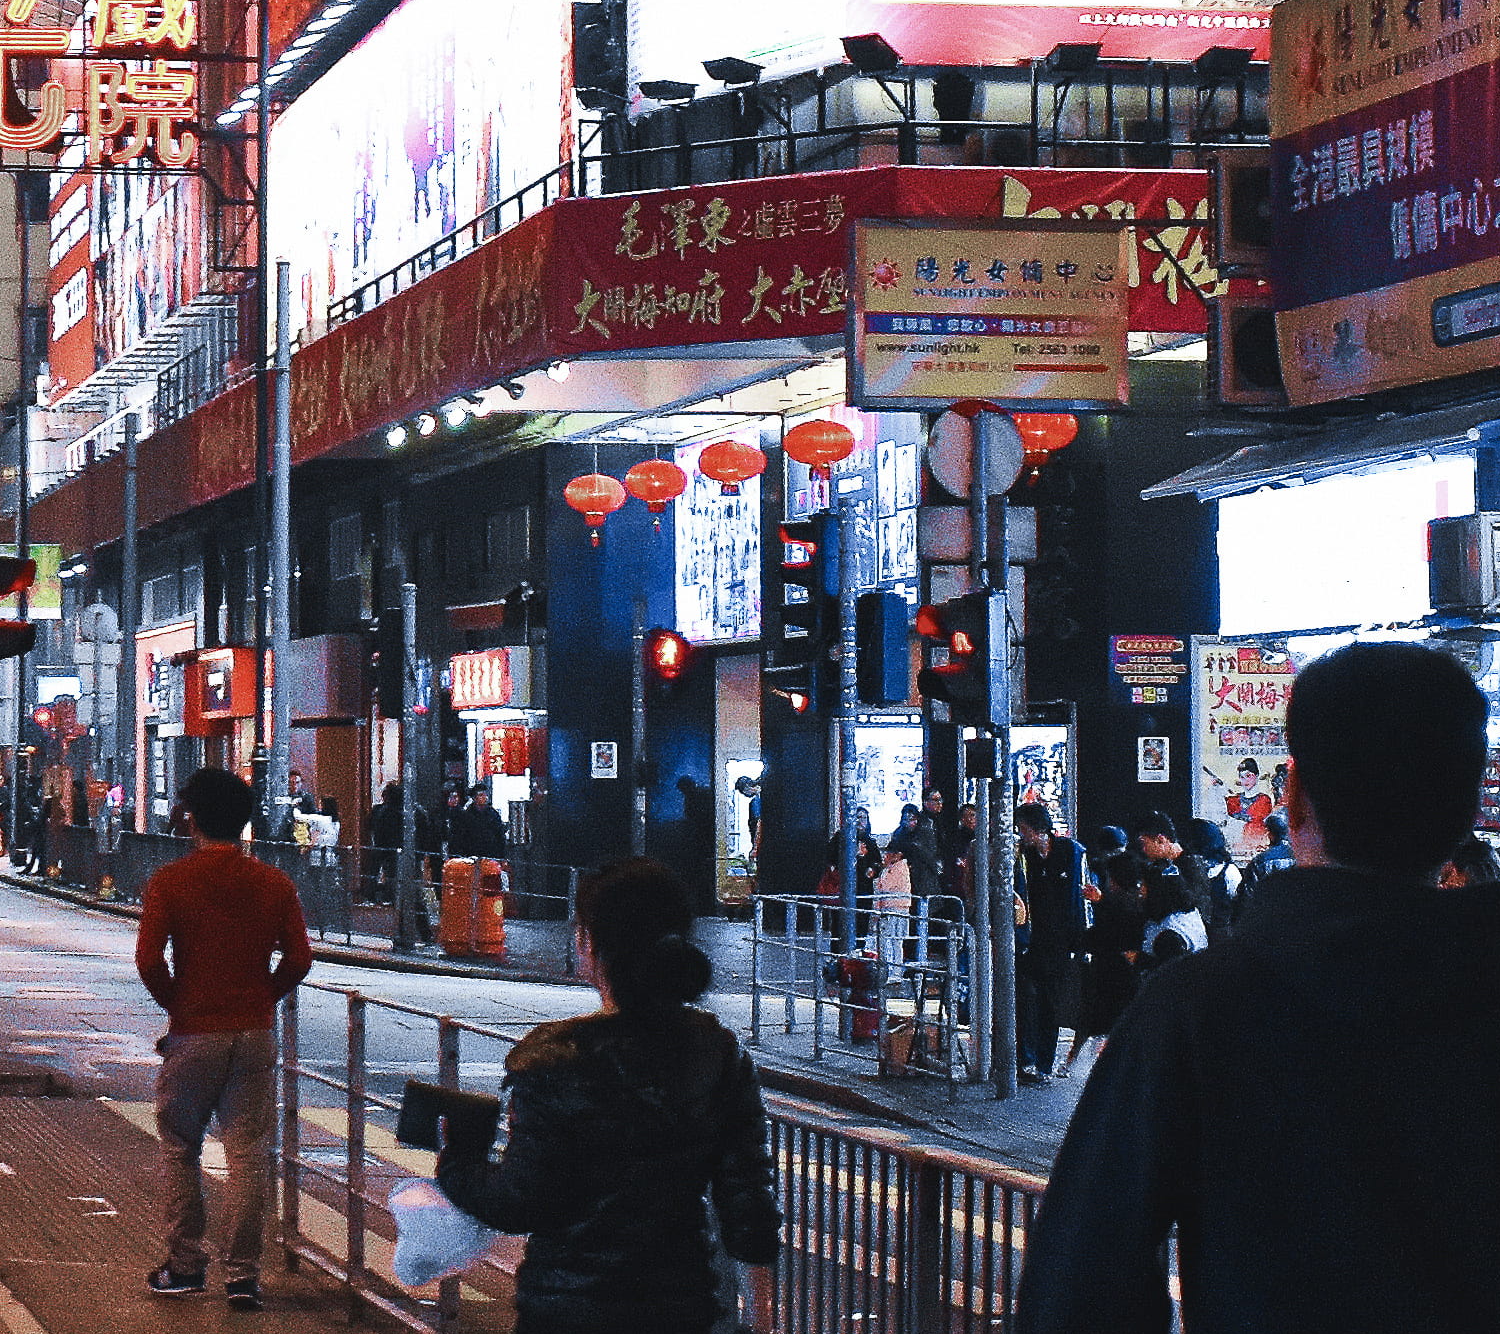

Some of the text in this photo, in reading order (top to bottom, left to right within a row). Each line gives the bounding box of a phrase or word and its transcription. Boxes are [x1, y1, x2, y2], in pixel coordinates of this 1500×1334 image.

[1289, 110, 1435, 213] 全港最具規模
[1211, 676, 1292, 713] 大鬧梅
